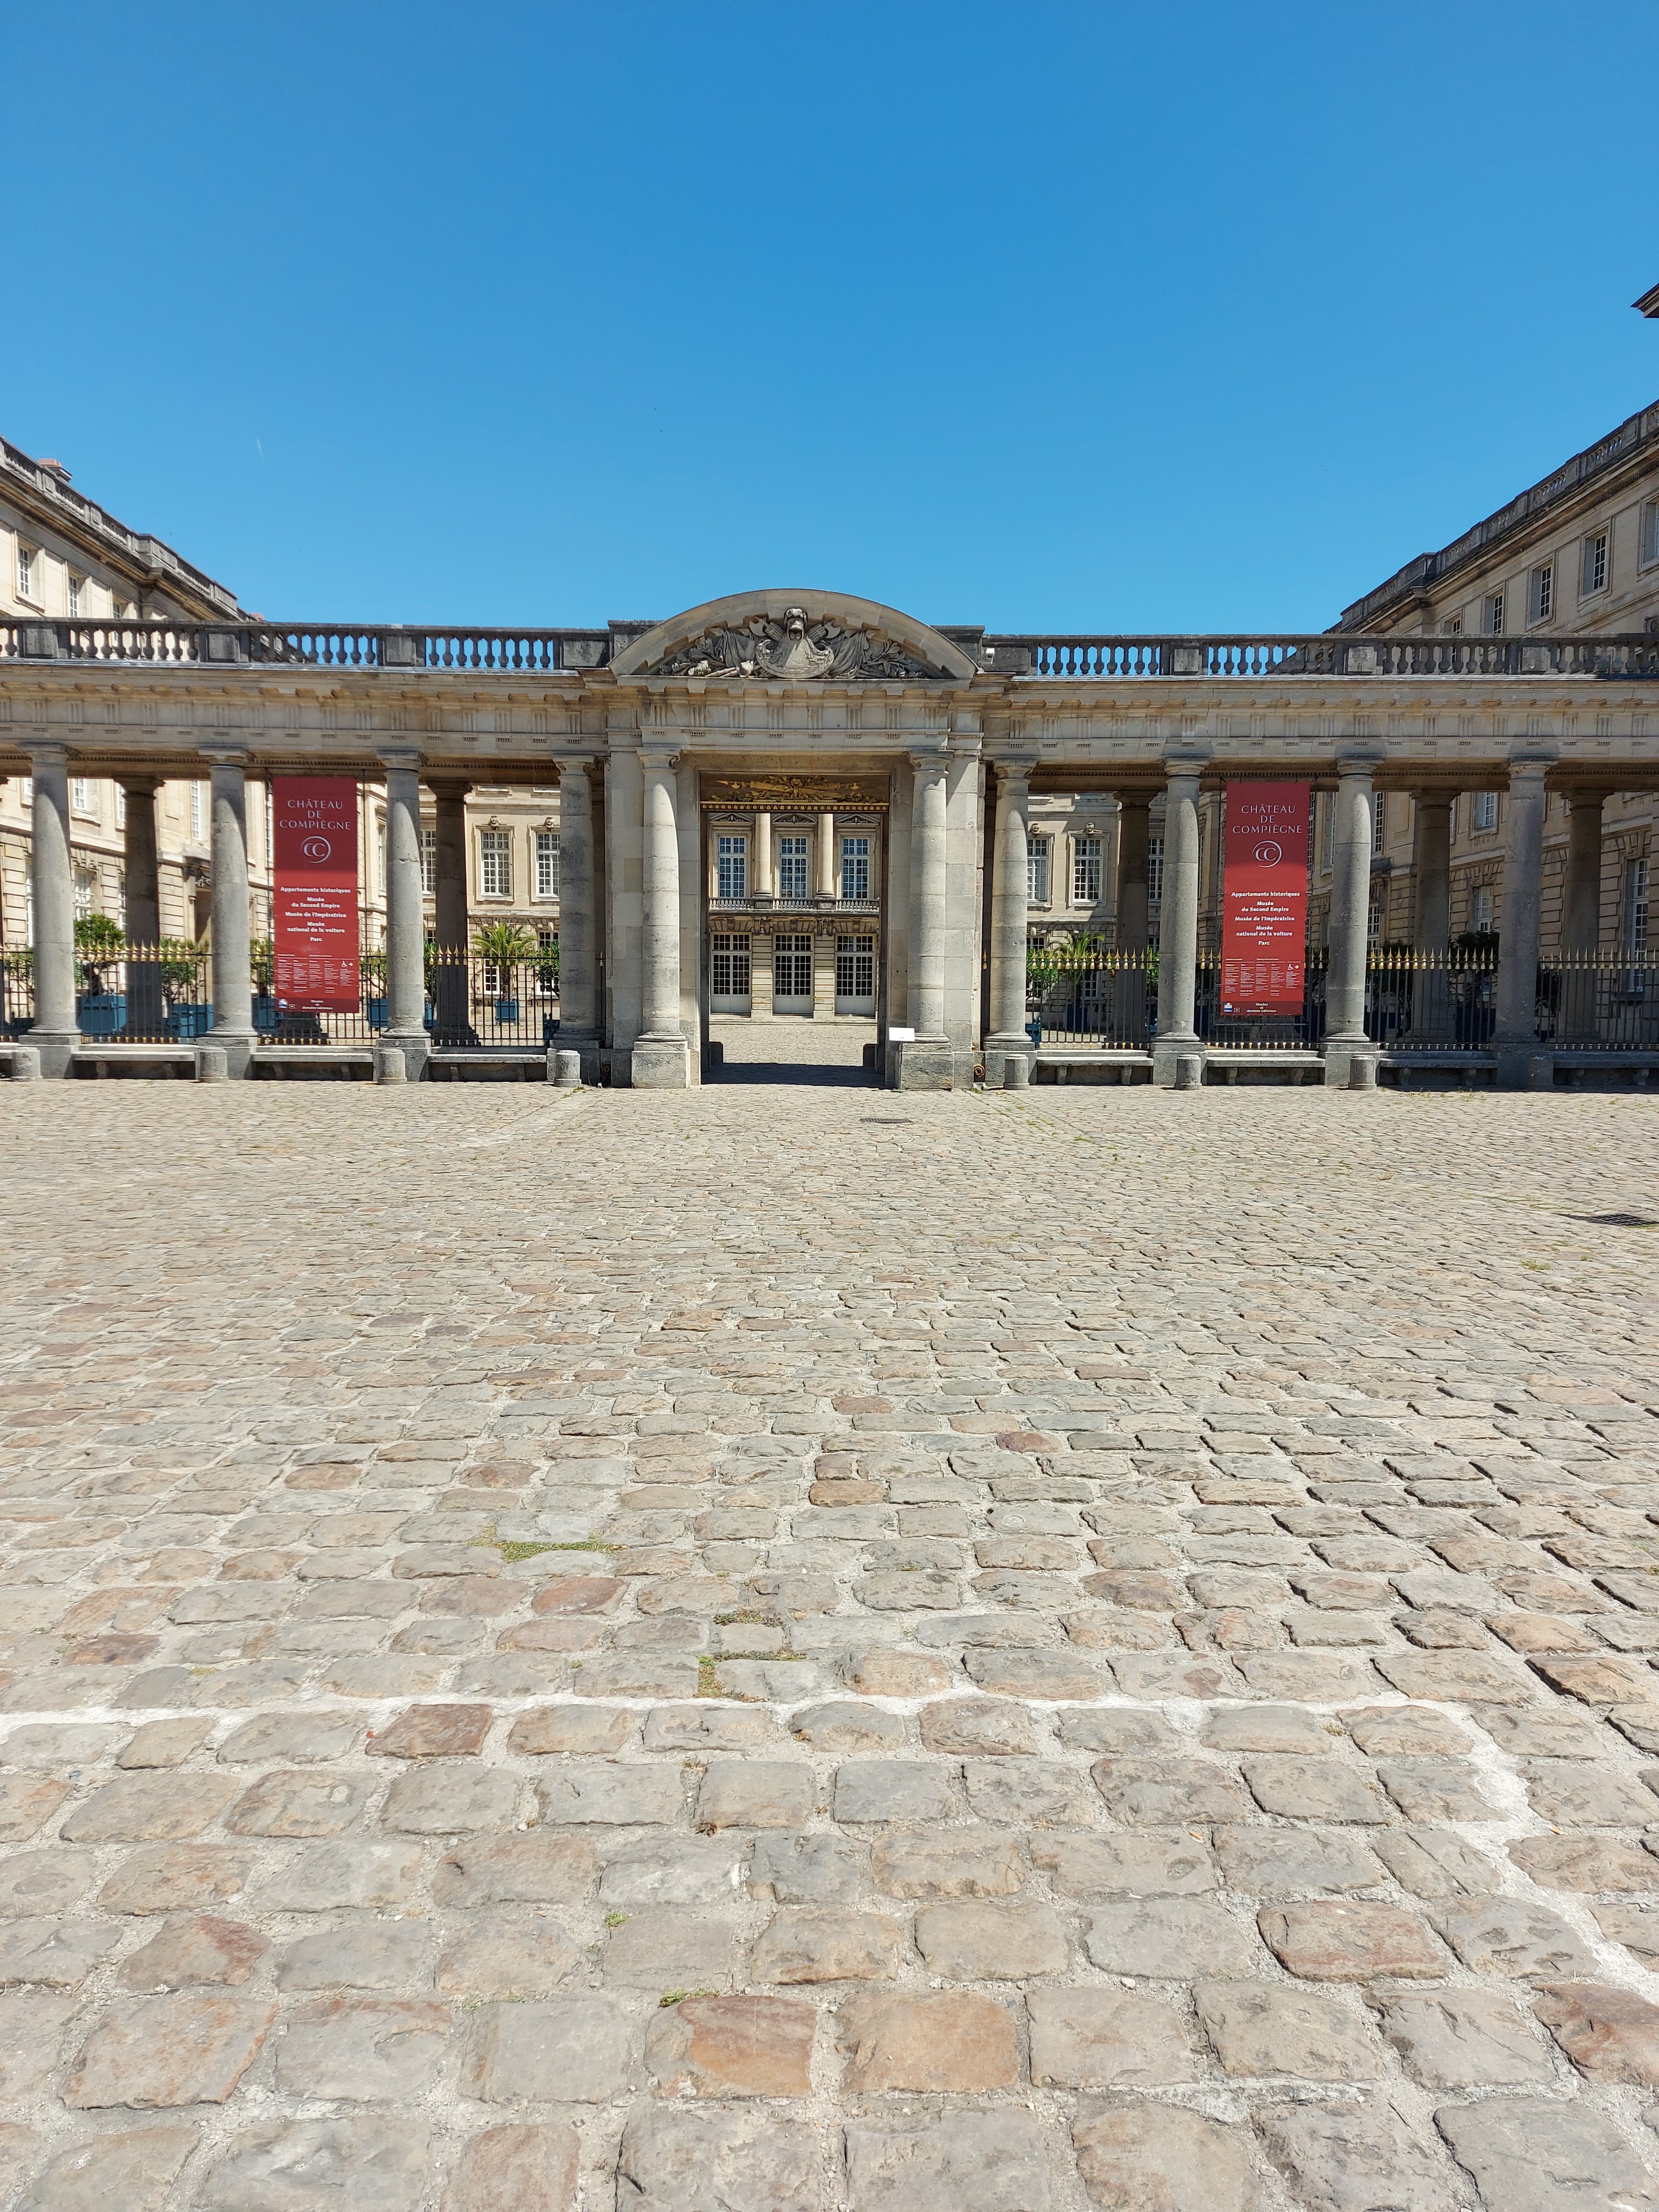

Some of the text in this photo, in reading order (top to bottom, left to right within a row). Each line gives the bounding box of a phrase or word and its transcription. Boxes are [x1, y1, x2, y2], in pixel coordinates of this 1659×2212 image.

[288, 799, 343, 809] CHÂTEAU
[1241, 804, 1295, 813] CHÂTEAU
[308, 810, 322, 818] DE
[1261, 815, 1275, 823] DE
[279, 819, 351, 830] COMPIÈGNE
[1233, 824, 1302, 834] COMPIÈGNE
